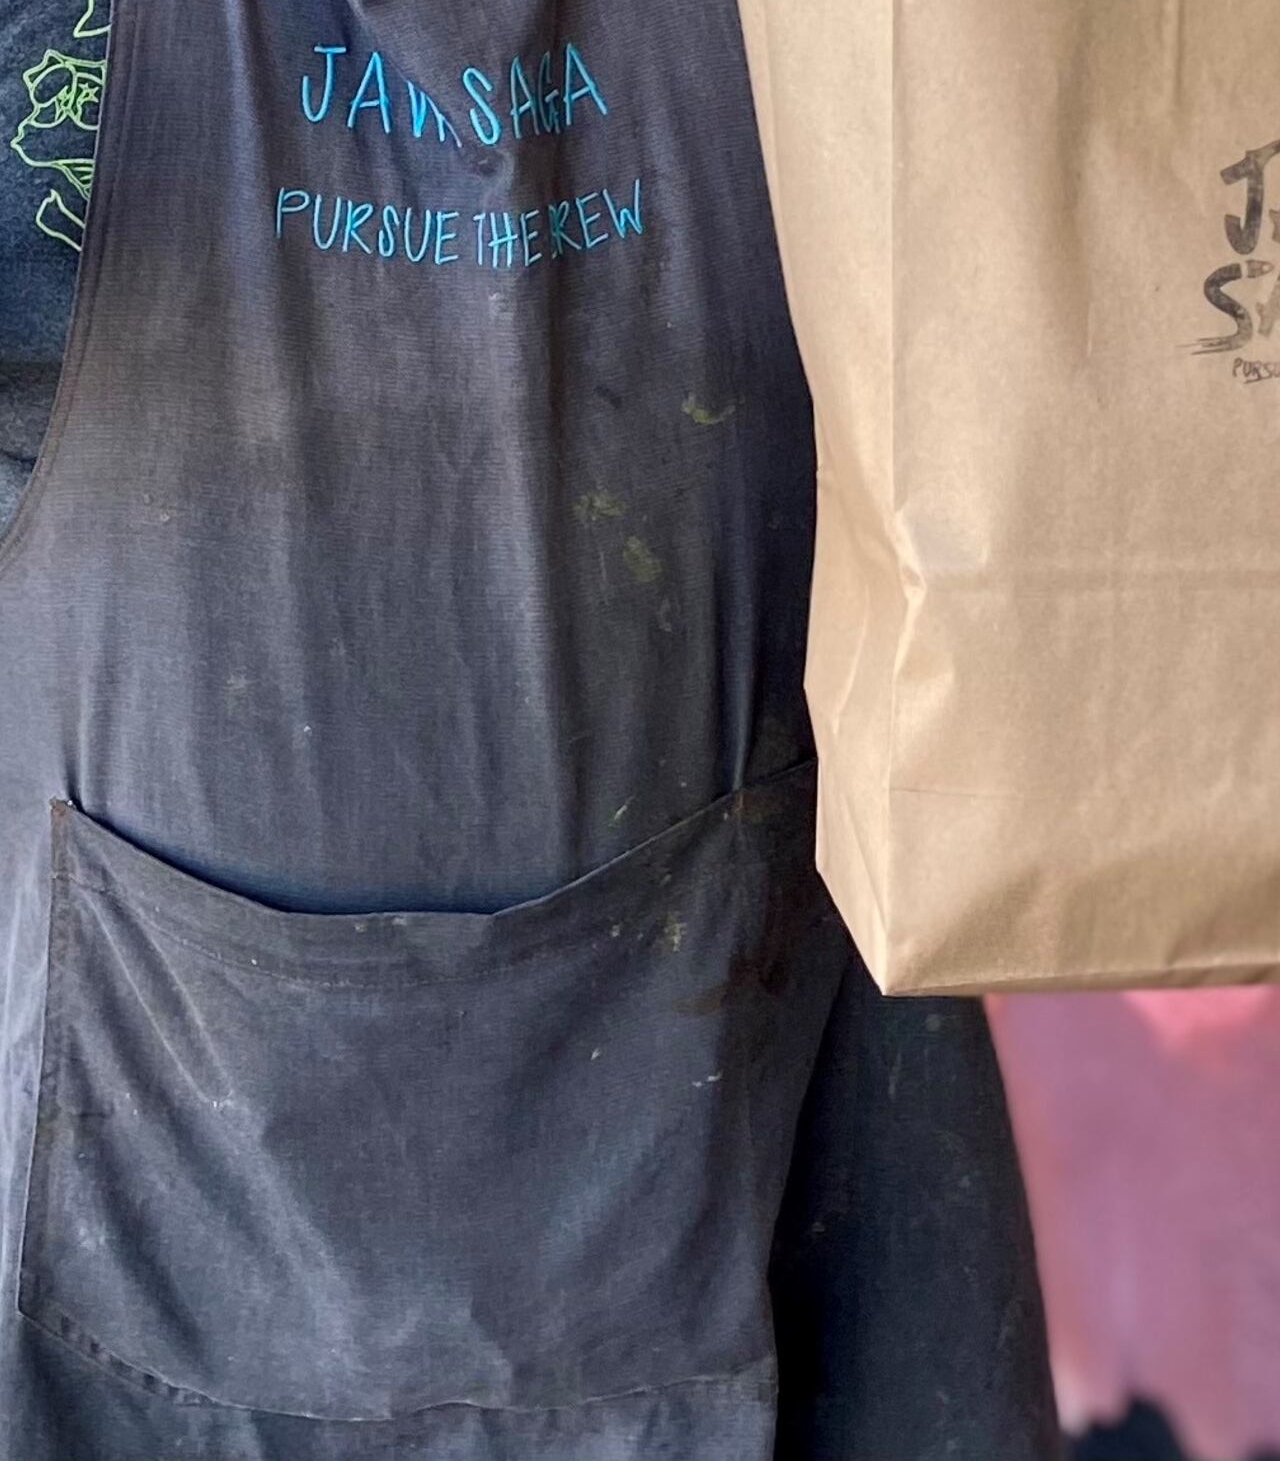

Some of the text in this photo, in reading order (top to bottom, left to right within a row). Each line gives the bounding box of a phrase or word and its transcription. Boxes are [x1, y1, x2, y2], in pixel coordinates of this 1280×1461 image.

[462, 42, 609, 146] SAGA
[276, 178, 644, 269] PURSUE THE REW
